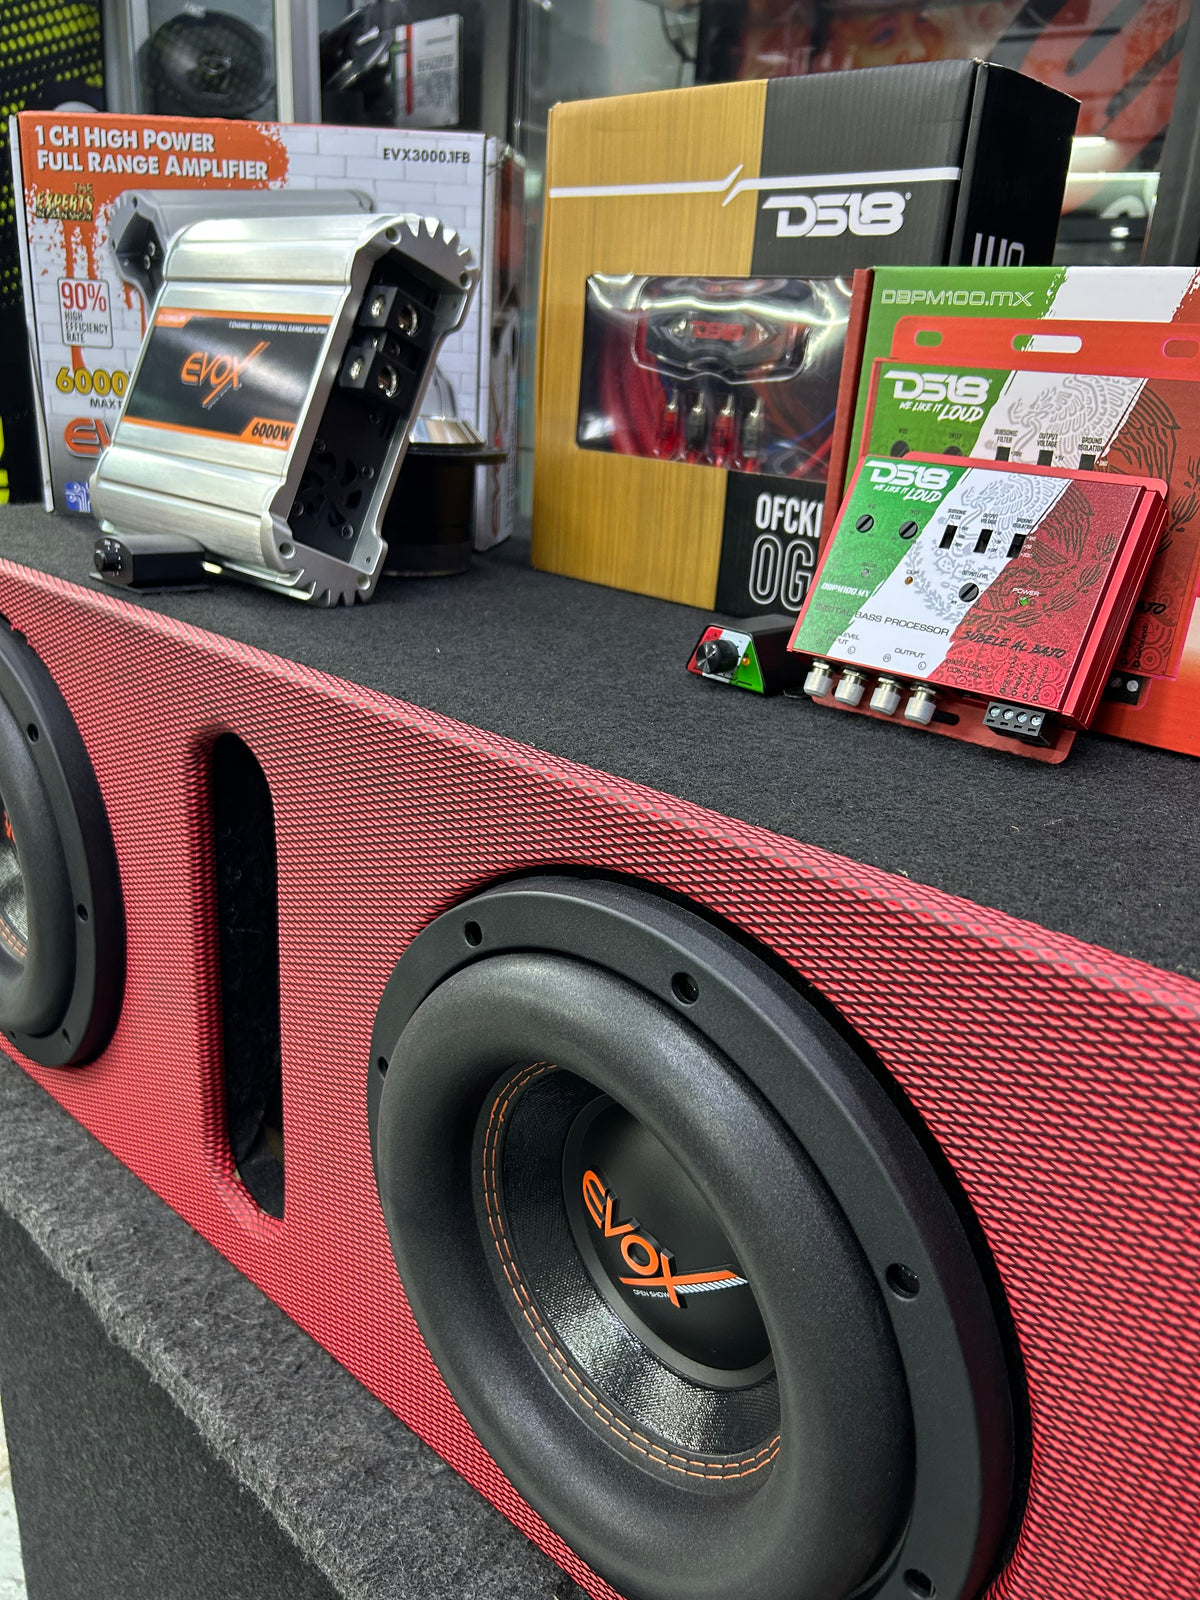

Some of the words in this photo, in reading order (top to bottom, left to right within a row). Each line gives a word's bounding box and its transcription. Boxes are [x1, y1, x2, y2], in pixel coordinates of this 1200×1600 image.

[34, 125, 44, 145] 1
[49, 125, 79, 147] CH
[84, 126, 138, 149] HIGH
[143, 129, 215, 152] POWER
[383, 147, 470, 164] EVX3000.1FB
[37, 149, 83, 172] FULL
[87, 152, 159, 176] RANGE
[165, 155, 268, 180] AMPLIFIER
[74, 182, 93, 194] THE
[36, 192, 94, 213] EXPERTS
[61, 281, 107, 312] 90%
[65, 310, 83, 321] HIGH
[66, 321, 108, 335] EFFICIENCY
[67, 332, 85, 343] RATE
[56, 366, 131, 397] 6000
[181, 341, 271, 410] EVOX
[884, 370, 989, 405] DS18
[90, 398, 115, 409] MAX
[899, 400, 913, 410] WE
[912, 402, 933, 412] LIKE
[932, 403, 943, 413] IT
[937, 403, 984, 423] LOUD
[252, 422, 293, 441] 6000W
[994, 428, 1018, 438] SUBSONIC
[1039, 432, 1058, 441] OUTPUT
[997, 436, 1013, 444] FILTER
[1037, 439, 1059, 448] VOLTAGE
[1081, 437, 1103, 445] GROUND
[1078, 444, 1104, 453] ISOLATION
[865, 460, 950, 490] DS18
[873, 483, 886, 492] WE
[884, 485, 901, 494] LIKE
[900, 487, 910, 495] IT
[903, 488, 943, 503] LOUD
[755, 492, 824, 538] OFCKI
[1012, 587, 1041, 598] POWER
[815, 602, 853, 618] DIGITAL
[855, 610, 882, 623] BASS
[884, 616, 950, 637] PROCESSOR
[960, 631, 1011, 648] SUBELE
[1010, 640, 1028, 653] AL
[1029, 644, 1067, 659] BAJO
[894, 647, 925, 659] OUTPUT
[582, 1170, 748, 1308] EVOX
